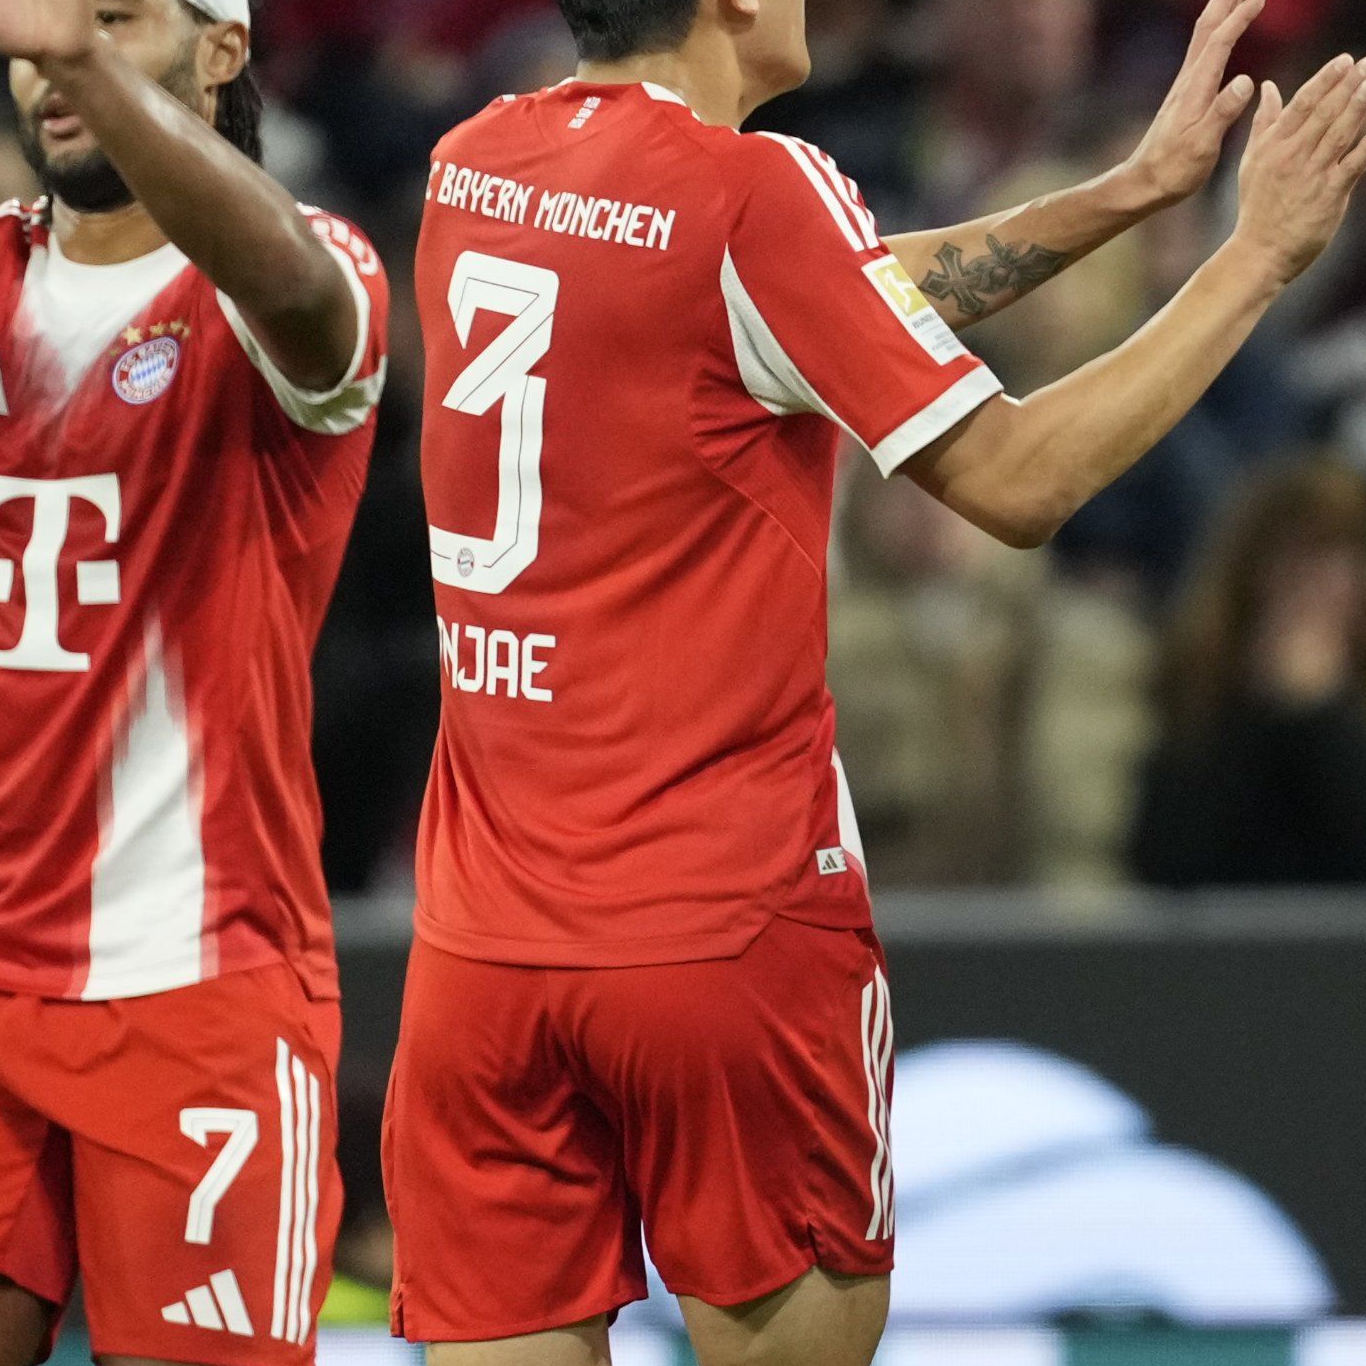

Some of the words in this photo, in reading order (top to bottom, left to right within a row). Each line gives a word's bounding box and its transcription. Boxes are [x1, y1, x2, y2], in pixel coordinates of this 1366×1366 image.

[436, 162, 535, 225] BAYERN
[533, 189, 676, 251] MÜNCHEN
[428, 250, 560, 595] 3
[436, 614, 556, 703] NJAE
[178, 1107, 259, 1245] 7
